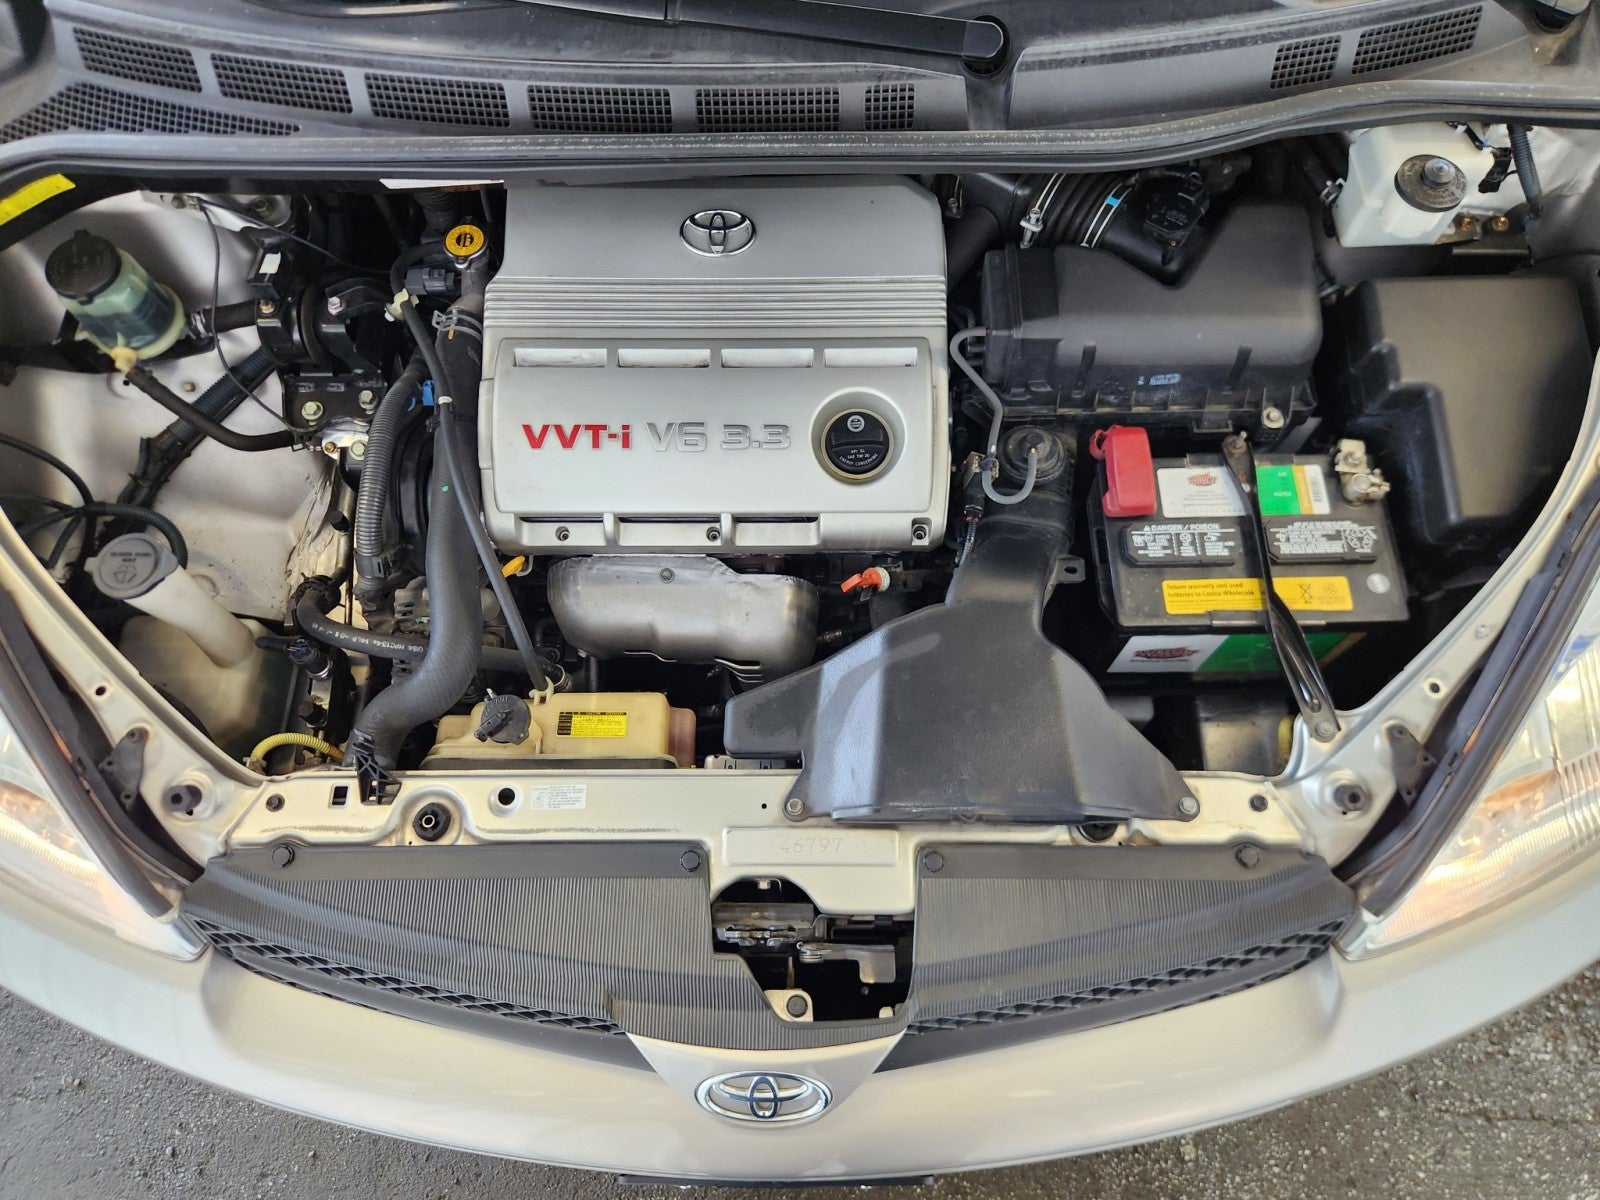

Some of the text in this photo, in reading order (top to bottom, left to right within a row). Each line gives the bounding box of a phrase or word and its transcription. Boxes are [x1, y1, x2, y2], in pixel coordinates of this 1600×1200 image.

[522, 422, 792, 452] VVT-i V6 3.3
[1151, 523, 1183, 532] DANGER
[1189, 522, 1220, 531] POISON
[1188, 583, 1215, 591] warranty
[1223, 589, 1254, 597] Wholesale
[780, 837, 842, 854] 46797
